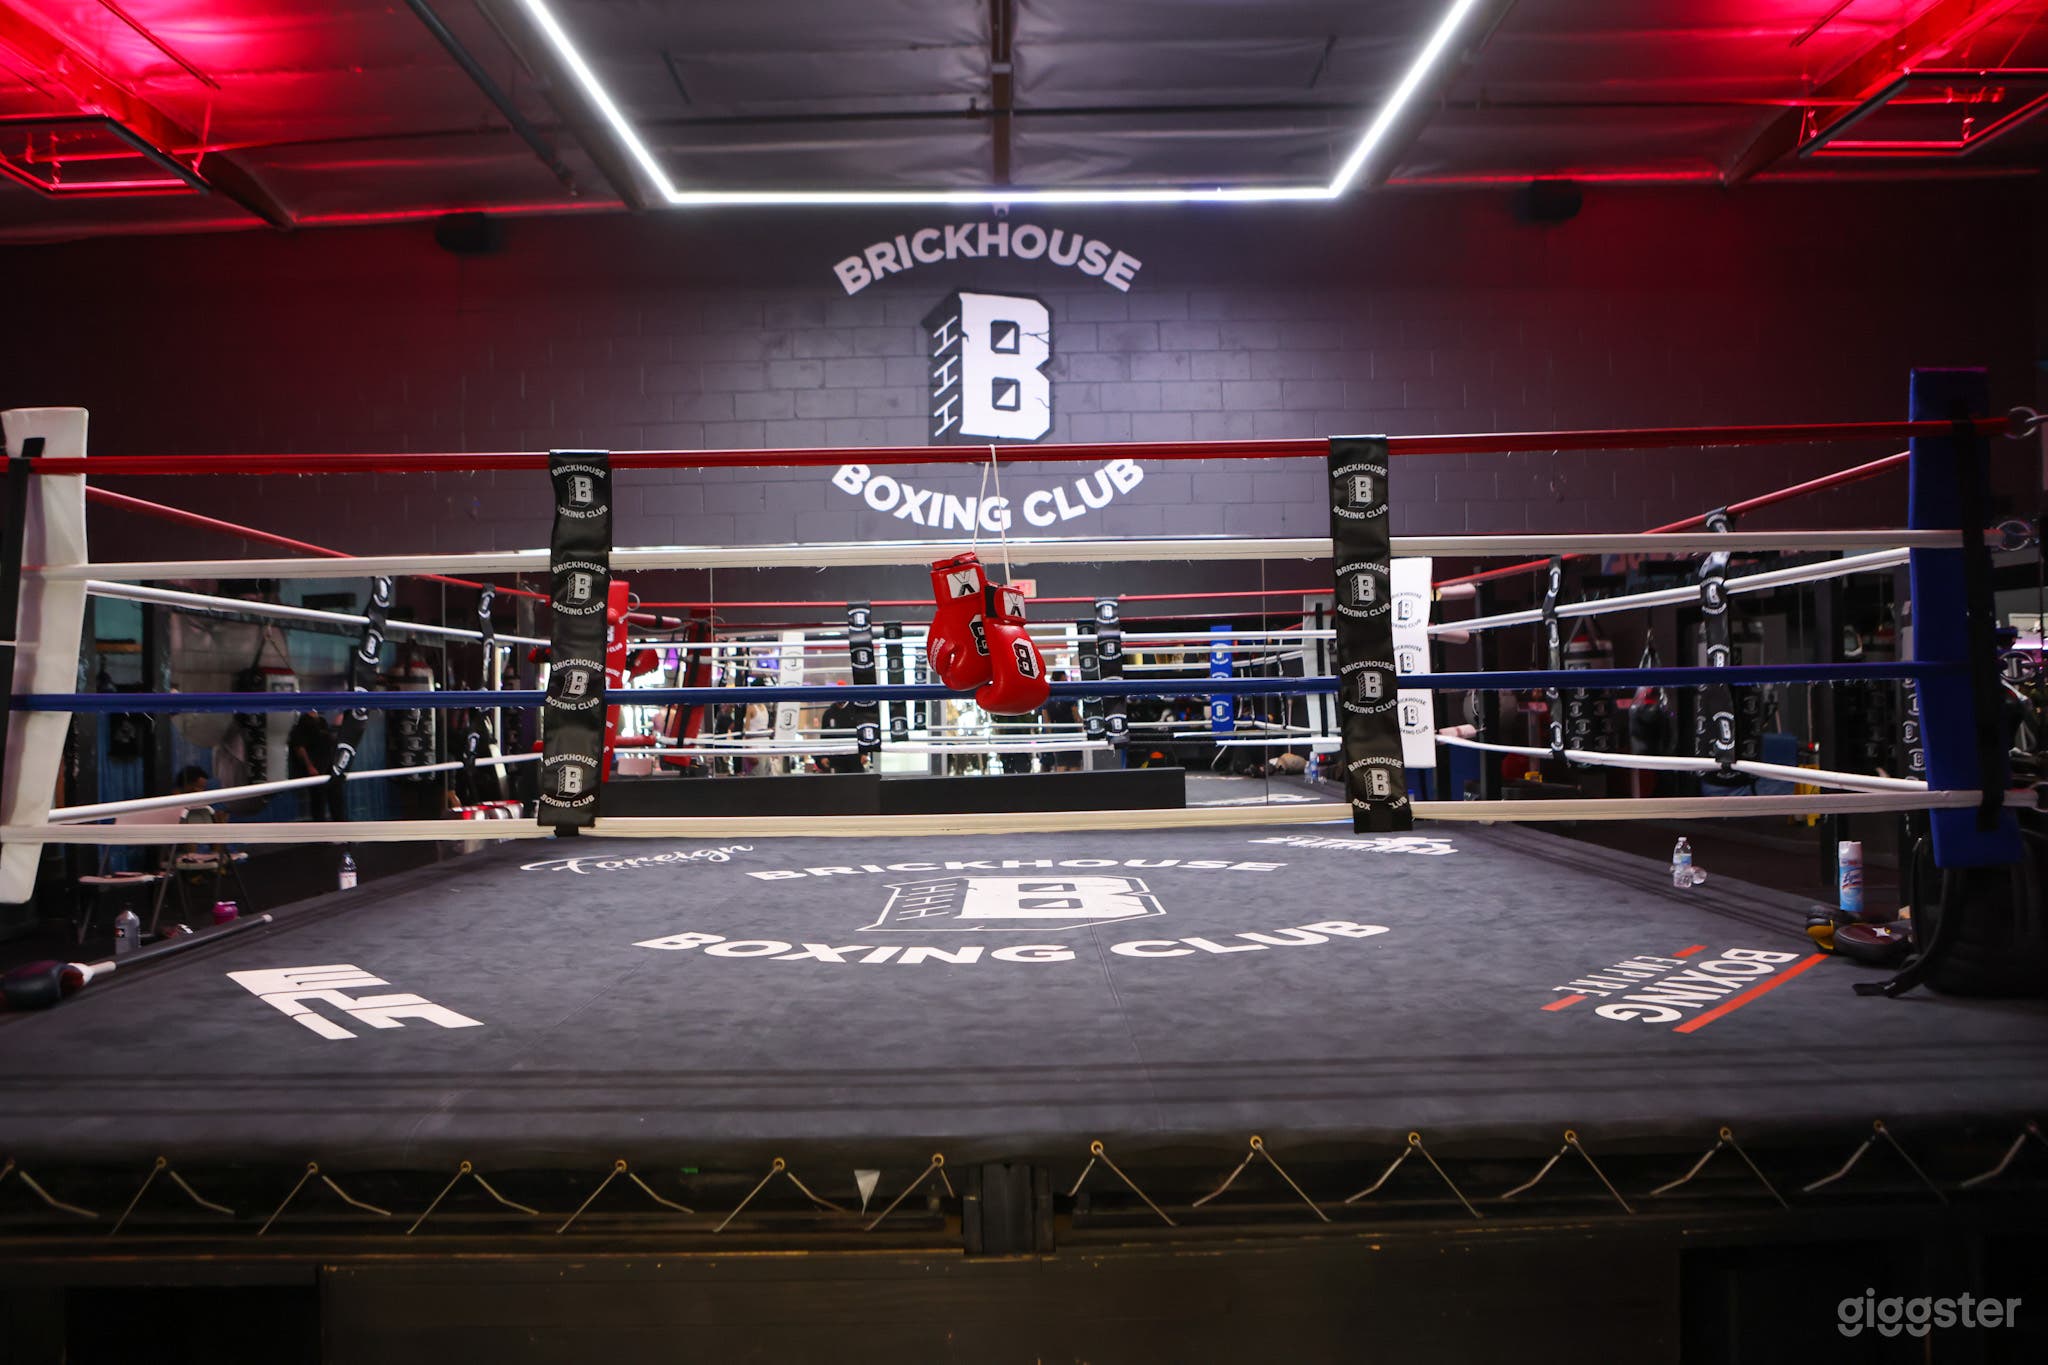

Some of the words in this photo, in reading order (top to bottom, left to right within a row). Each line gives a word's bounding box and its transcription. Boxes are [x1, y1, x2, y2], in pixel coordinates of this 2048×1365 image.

[833, 222, 1143, 296] BRICKHOUSE
[959, 292, 1051, 441] B
[552, 464, 606, 479] BRICKHOUSE
[1332, 463, 1387, 478] BRICKHOUSE
[832, 463, 1012, 532] BOXING
[1023, 458, 1145, 527] CLUB
[586, 505, 608, 518] CLUB
[1333, 505, 1365, 519] BOXING
[1366, 504, 1388, 519] CLUB
[552, 561, 607, 575] BRICKHOUSE
[1335, 562, 1389, 577] BRICKHOUSE
[552, 601, 583, 616] BOXING
[583, 601, 605, 615] CLUB
[1336, 604, 1368, 618] BOXING
[1369, 602, 1391, 617] CLUB
[552, 658, 603, 673] BRICKHOUSE
[1341, 660, 1395, 675] BRICKHOUSE
[545, 696, 577, 711] BOXING
[578, 697, 600, 710] CLUB
[1343, 700, 1374, 714] BOXING
[1375, 699, 1397, 712] CLUB
[544, 753, 598, 768] BRICKHOUSE
[1348, 756, 1403, 772] BRICKHOUSE
[540, 794, 571, 809] BOXING
[572, 794, 595, 808] CLUB
[1388, 796, 1408, 809] LUB
[746, 859, 1289, 881] BRICKHOUSE
[632, 931, 1076, 964] BOXING
[1110, 920, 1391, 958] CLUB
[1552, 955, 1668, 998] EMPIRE
[1594, 948, 1800, 1023] BOXING
